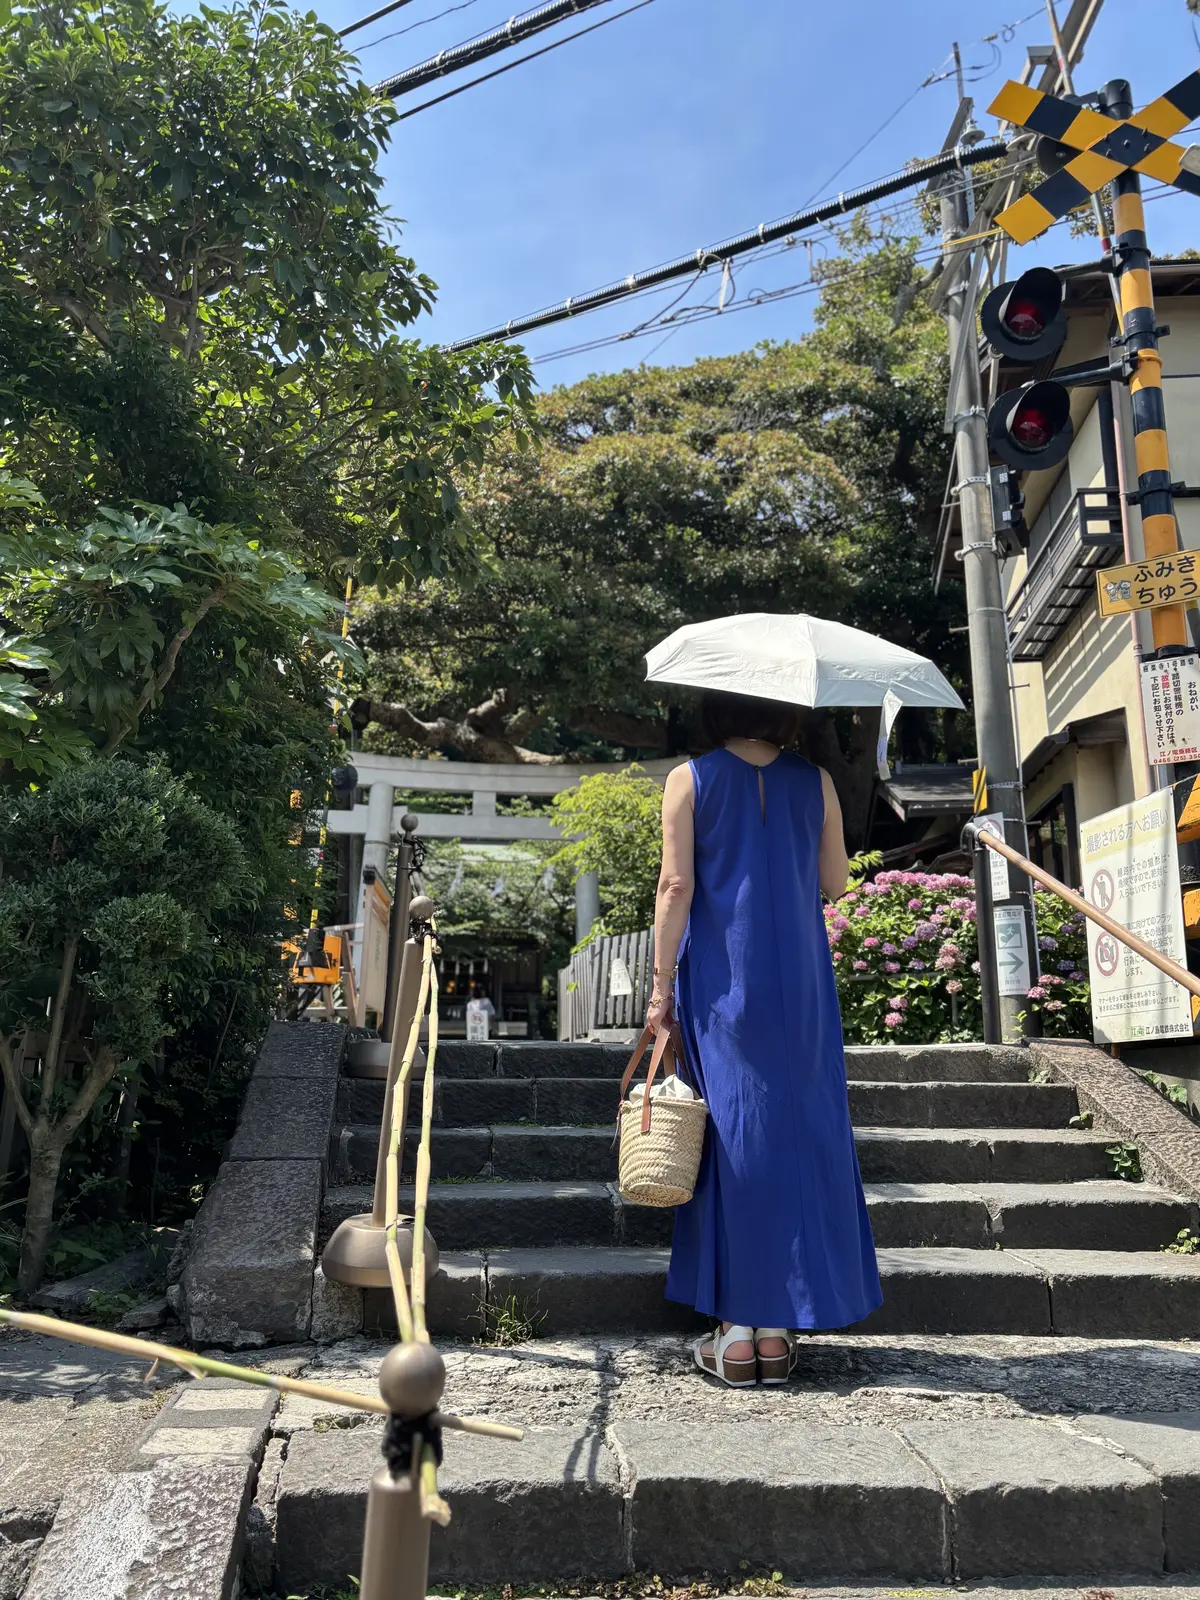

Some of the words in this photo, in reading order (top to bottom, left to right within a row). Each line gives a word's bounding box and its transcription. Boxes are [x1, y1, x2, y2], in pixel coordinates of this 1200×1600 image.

[1133, 555, 1196, 583] ふみき
[1136, 577, 1198, 605] ちゅう
[1150, 676, 1165, 748] 下記にお知らせ下さい
[1187, 681, 1199, 712] おねがい
[1086, 808, 1169, 854] 撮影される方へお願い
